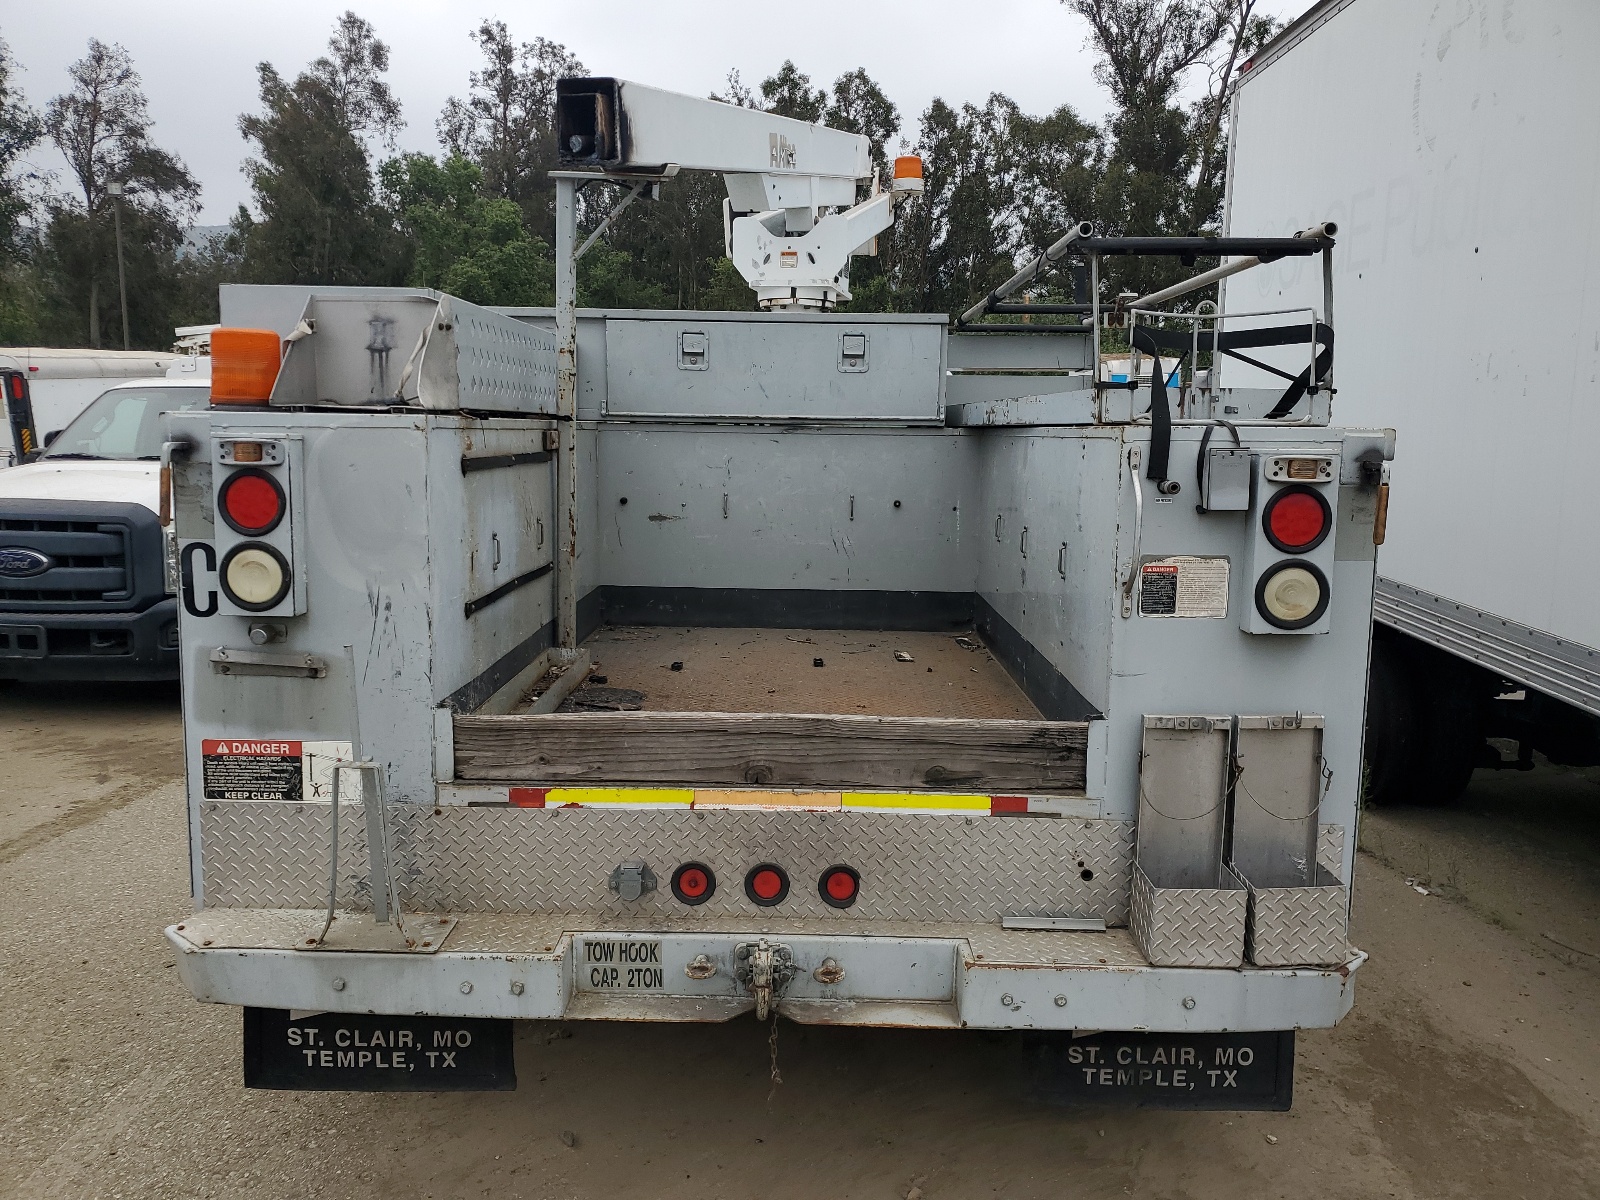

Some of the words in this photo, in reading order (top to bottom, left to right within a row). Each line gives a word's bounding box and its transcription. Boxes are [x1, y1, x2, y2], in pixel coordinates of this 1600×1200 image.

[0, 553, 31, 570] Ford
[232, 742, 290, 754] DANGER
[224, 791, 249, 799] KEEP
[251, 792, 282, 800] CLEAR
[585, 942, 615, 961] TOW
[619, 942, 659, 962] HOOK
[591, 968, 620, 987] CAP.
[628, 968, 662, 988] 2TON
[287, 1027, 324, 1046] ST.
[335, 1029, 422, 1050] CLAIR,
[433, 1030, 472, 1048] MO
[303, 1050, 415, 1071] TEMPLE,
[426, 1051, 456, 1068] TX
[1068, 1046, 1105, 1064] ST.
[1116, 1046, 1203, 1069] CLAIR,
[1215, 1047, 1254, 1066] MO
[1082, 1068, 1195, 1090] TEMPLE,
[1207, 1070, 1238, 1087] TX
